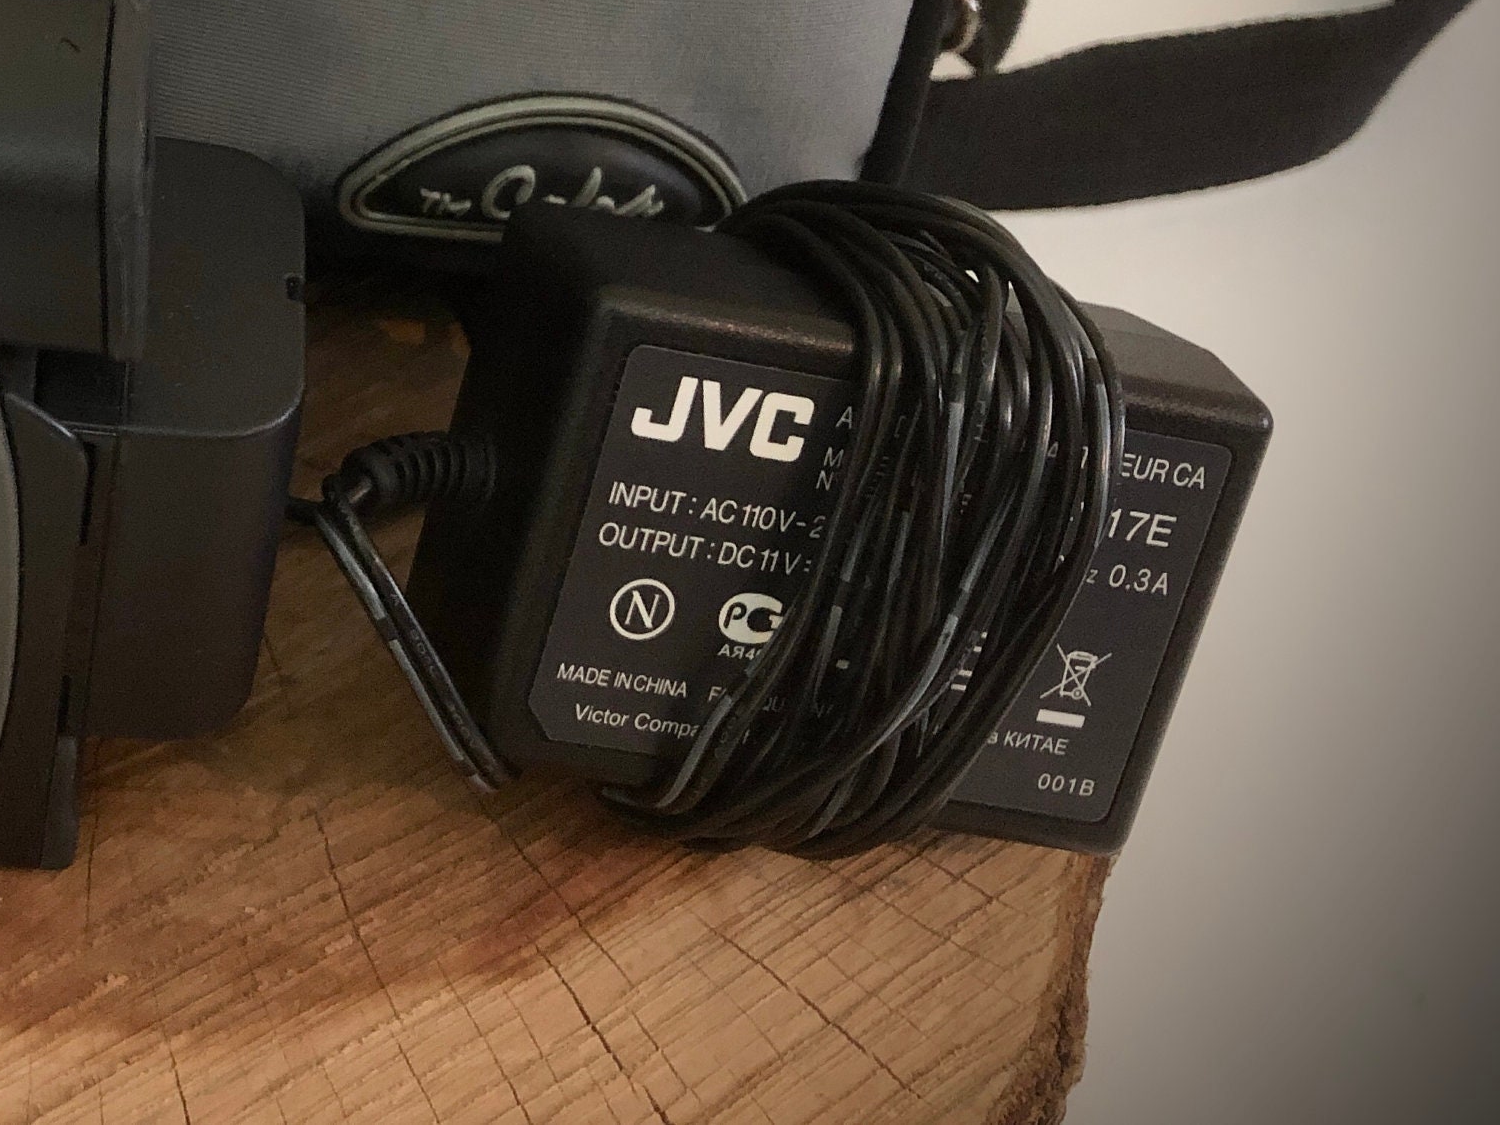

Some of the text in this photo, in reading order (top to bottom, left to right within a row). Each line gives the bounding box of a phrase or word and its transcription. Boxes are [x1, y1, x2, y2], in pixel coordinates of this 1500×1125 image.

[631, 376, 815, 462] JVC
[1121, 453, 1170, 483] EUR
[1173, 462, 1206, 490] CA
[1107, 508, 1178, 548] 17E
[1108, 564, 1169, 596] 0.3A
[557, 663, 688, 698] MADE IN CHINA
[574, 703, 630, 728] Victor
[1003, 730, 1070, 755] КИТАЕ
[1037, 772, 1096, 797] 001B
